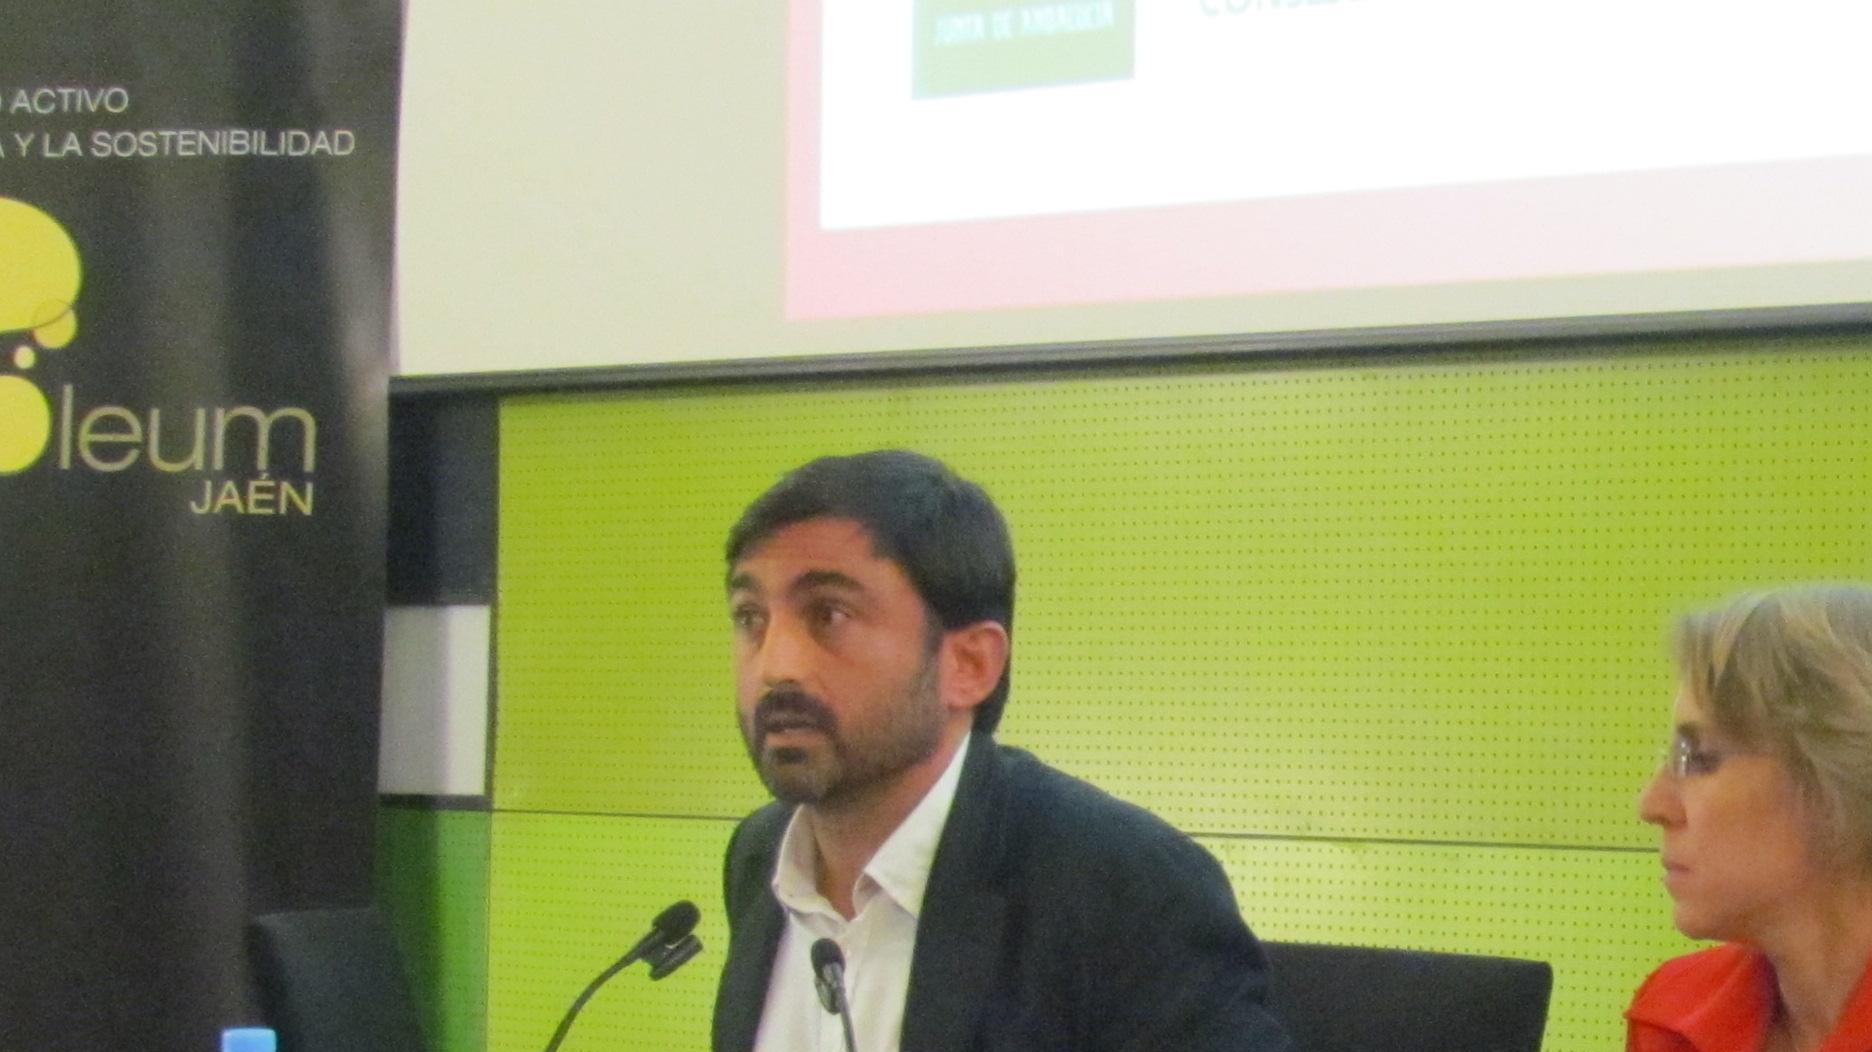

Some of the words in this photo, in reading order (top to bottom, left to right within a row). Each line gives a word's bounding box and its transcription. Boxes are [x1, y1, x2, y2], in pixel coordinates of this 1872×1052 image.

[9, 87, 129, 114] ACTIVO
[14, 132, 35, 158] Y
[42, 132, 83, 158] LA
[90, 130, 356, 158] SOSTENIBILIDAD
[190, 472, 315, 516] JAÉN
